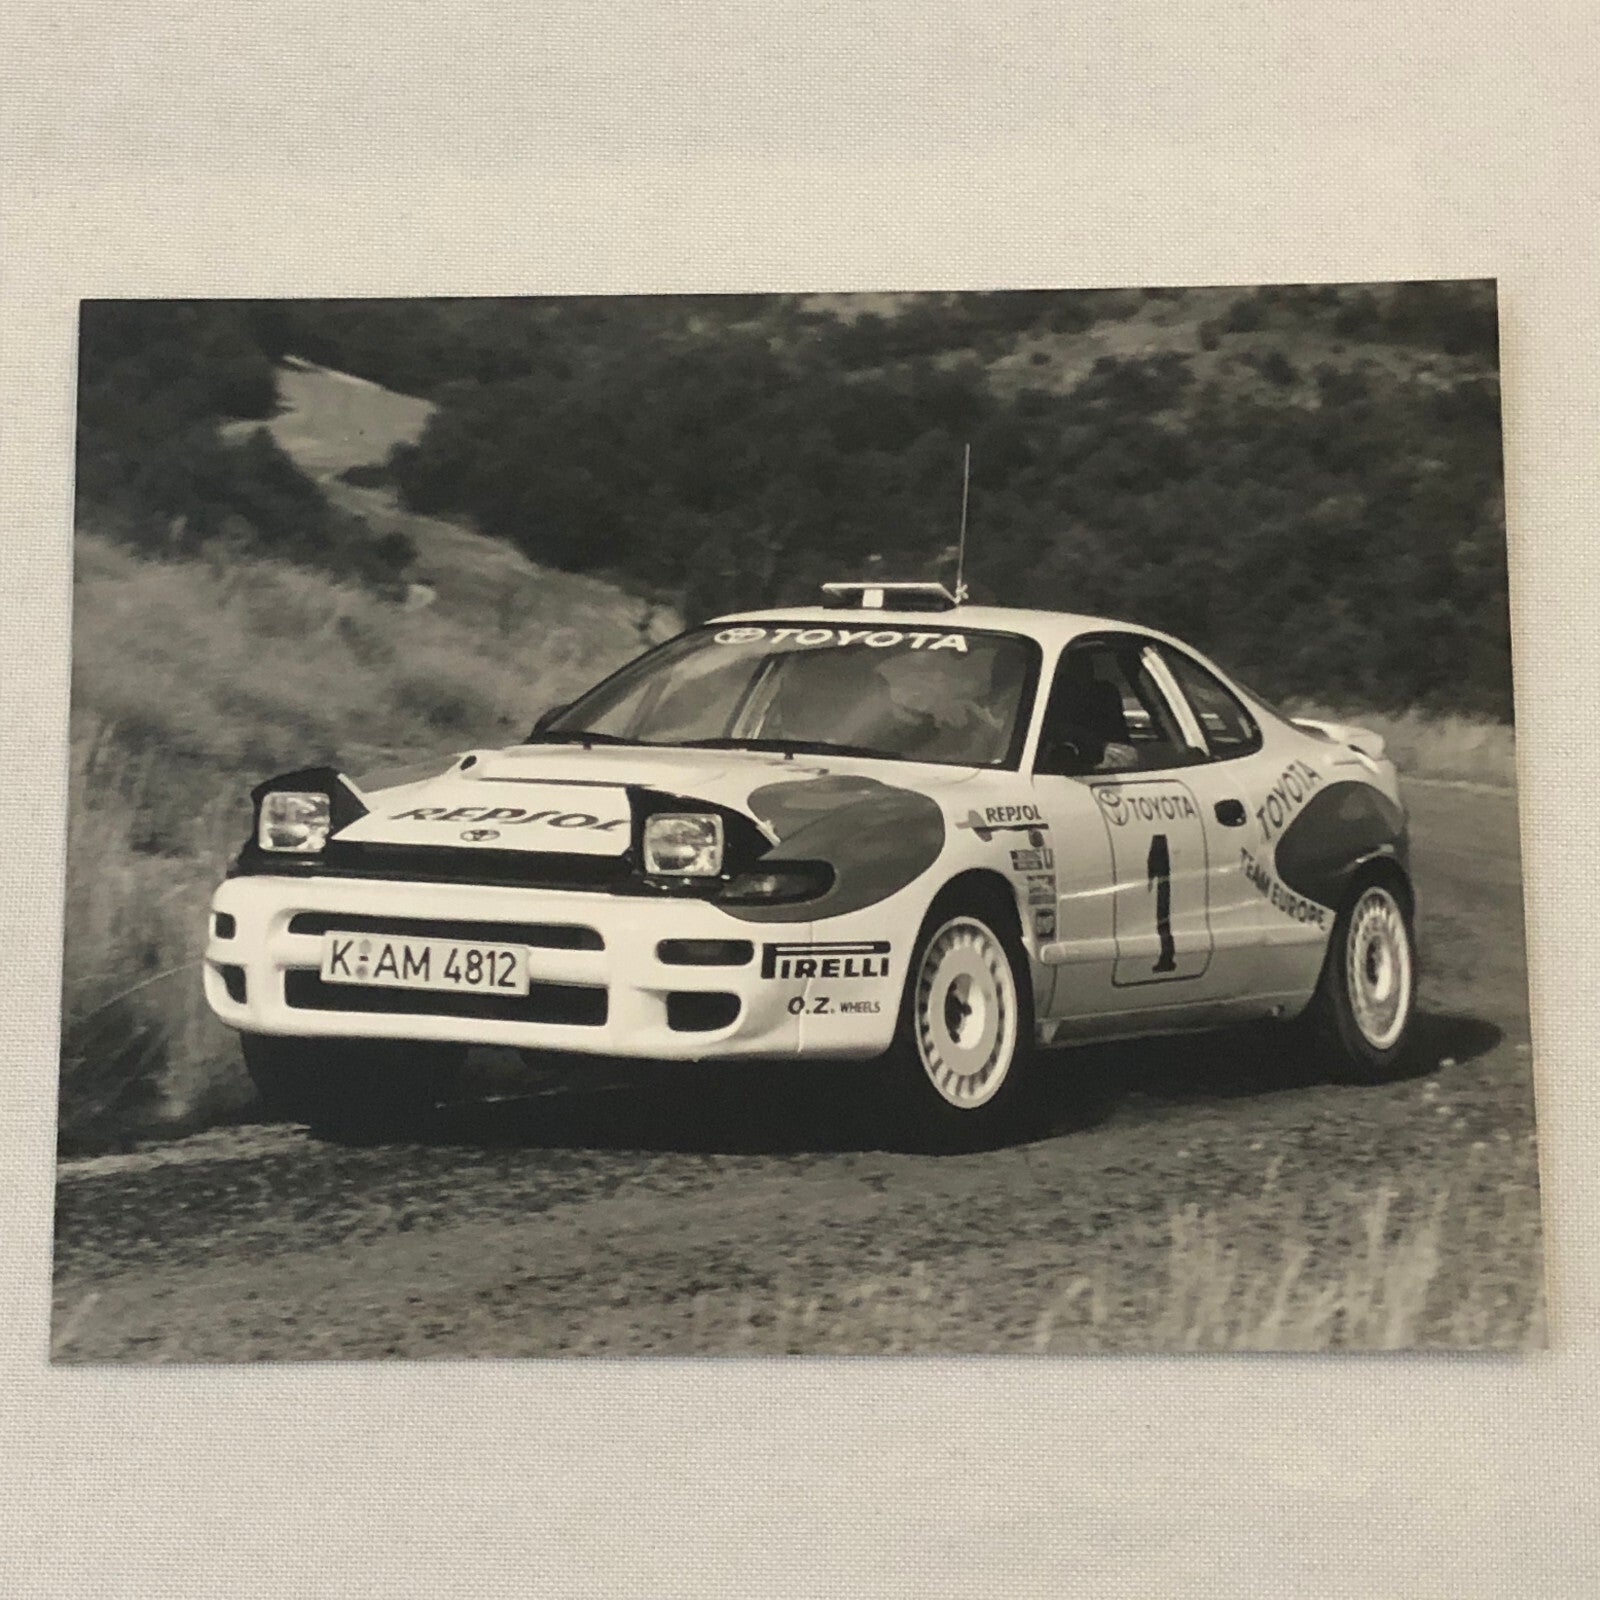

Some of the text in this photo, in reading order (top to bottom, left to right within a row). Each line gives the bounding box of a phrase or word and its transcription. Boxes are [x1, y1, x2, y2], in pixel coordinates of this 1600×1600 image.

[769, 628, 968, 652] TOYOTA
[985, 804, 1042, 823] REPSOL
[1127, 795, 1198, 821] TOYOTA
[1256, 759, 1324, 840] TOYOTA
[389, 807, 630, 832] REPSOL
[1146, 834, 1177, 974] 1
[1240, 846, 1327, 931] TEAM EUROPE
[444, 949, 517, 988] 4812
[761, 940, 891, 979] PIRELLI
[787, 996, 881, 1015] O.Z. WHEELS
